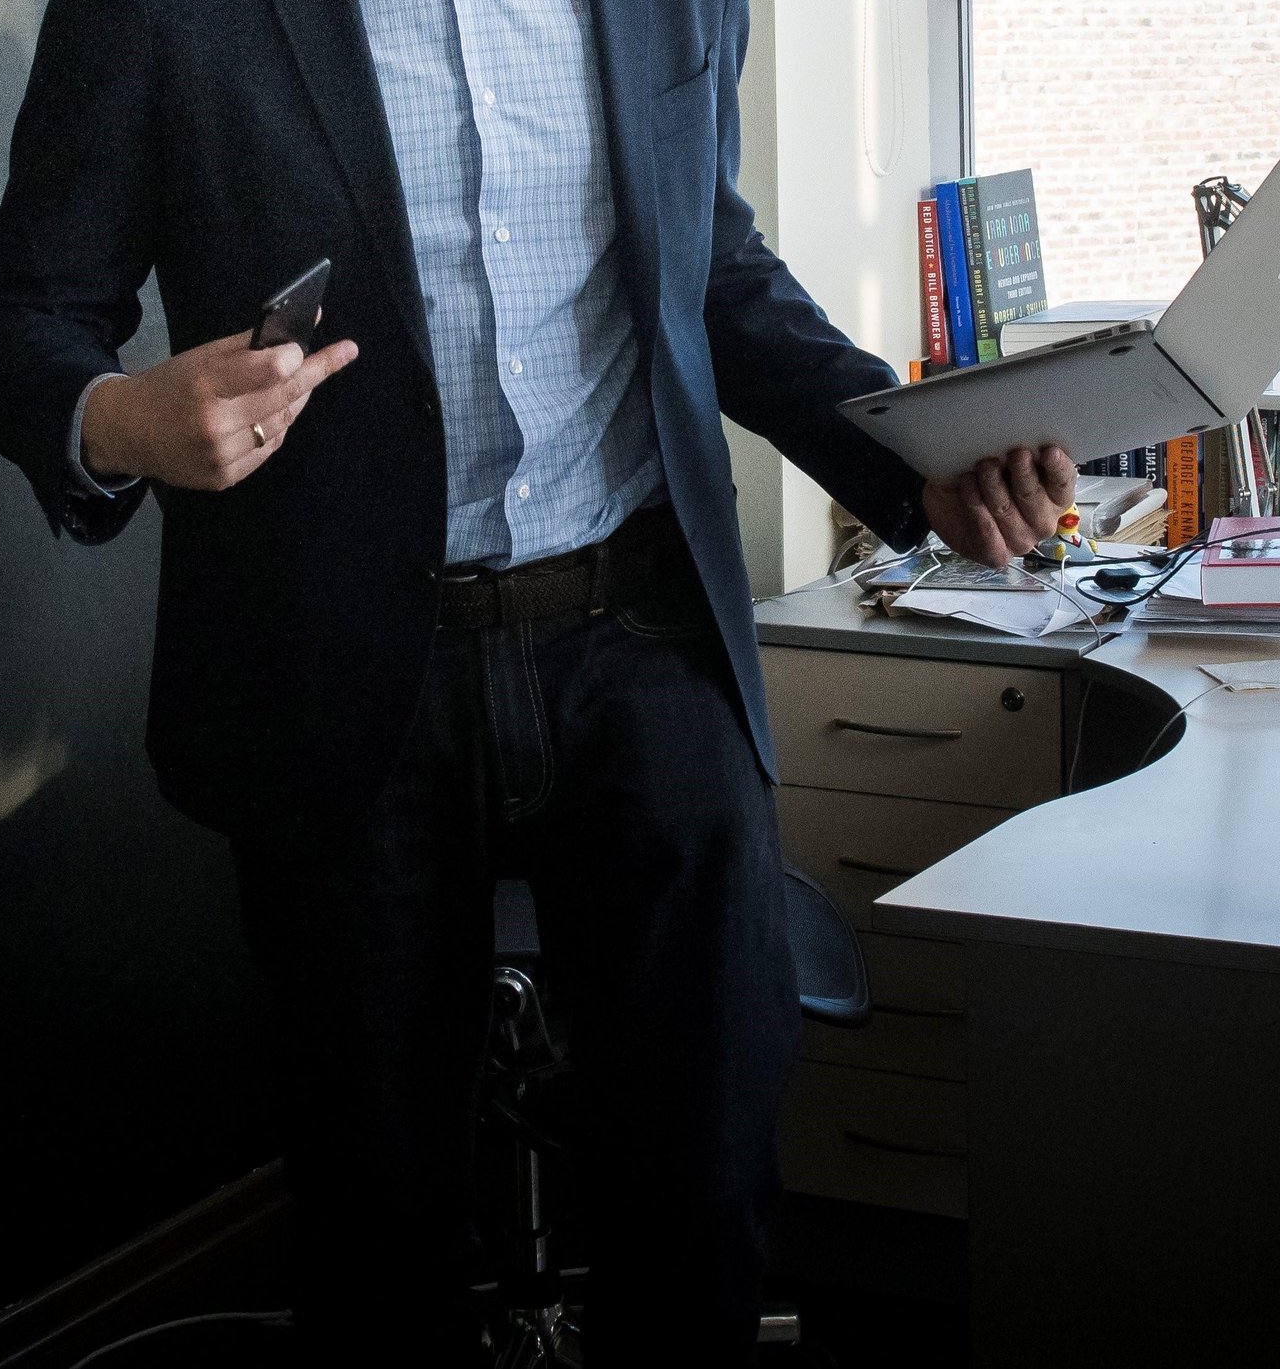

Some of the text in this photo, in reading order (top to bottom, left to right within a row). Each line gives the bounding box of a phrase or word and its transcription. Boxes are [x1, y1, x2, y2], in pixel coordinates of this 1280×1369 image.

[922, 206, 935, 259] RED NOTICE
[927, 272, 941, 339] BILL BROWDER
[974, 269, 988, 338] ROBERT J. SHILLER
[994, 307, 1016, 324] ROBERT
[1019, 307, 1026, 317] J.
[1181, 441, 1194, 484] GEORGE
[1181, 502, 1194, 543] KENNA
